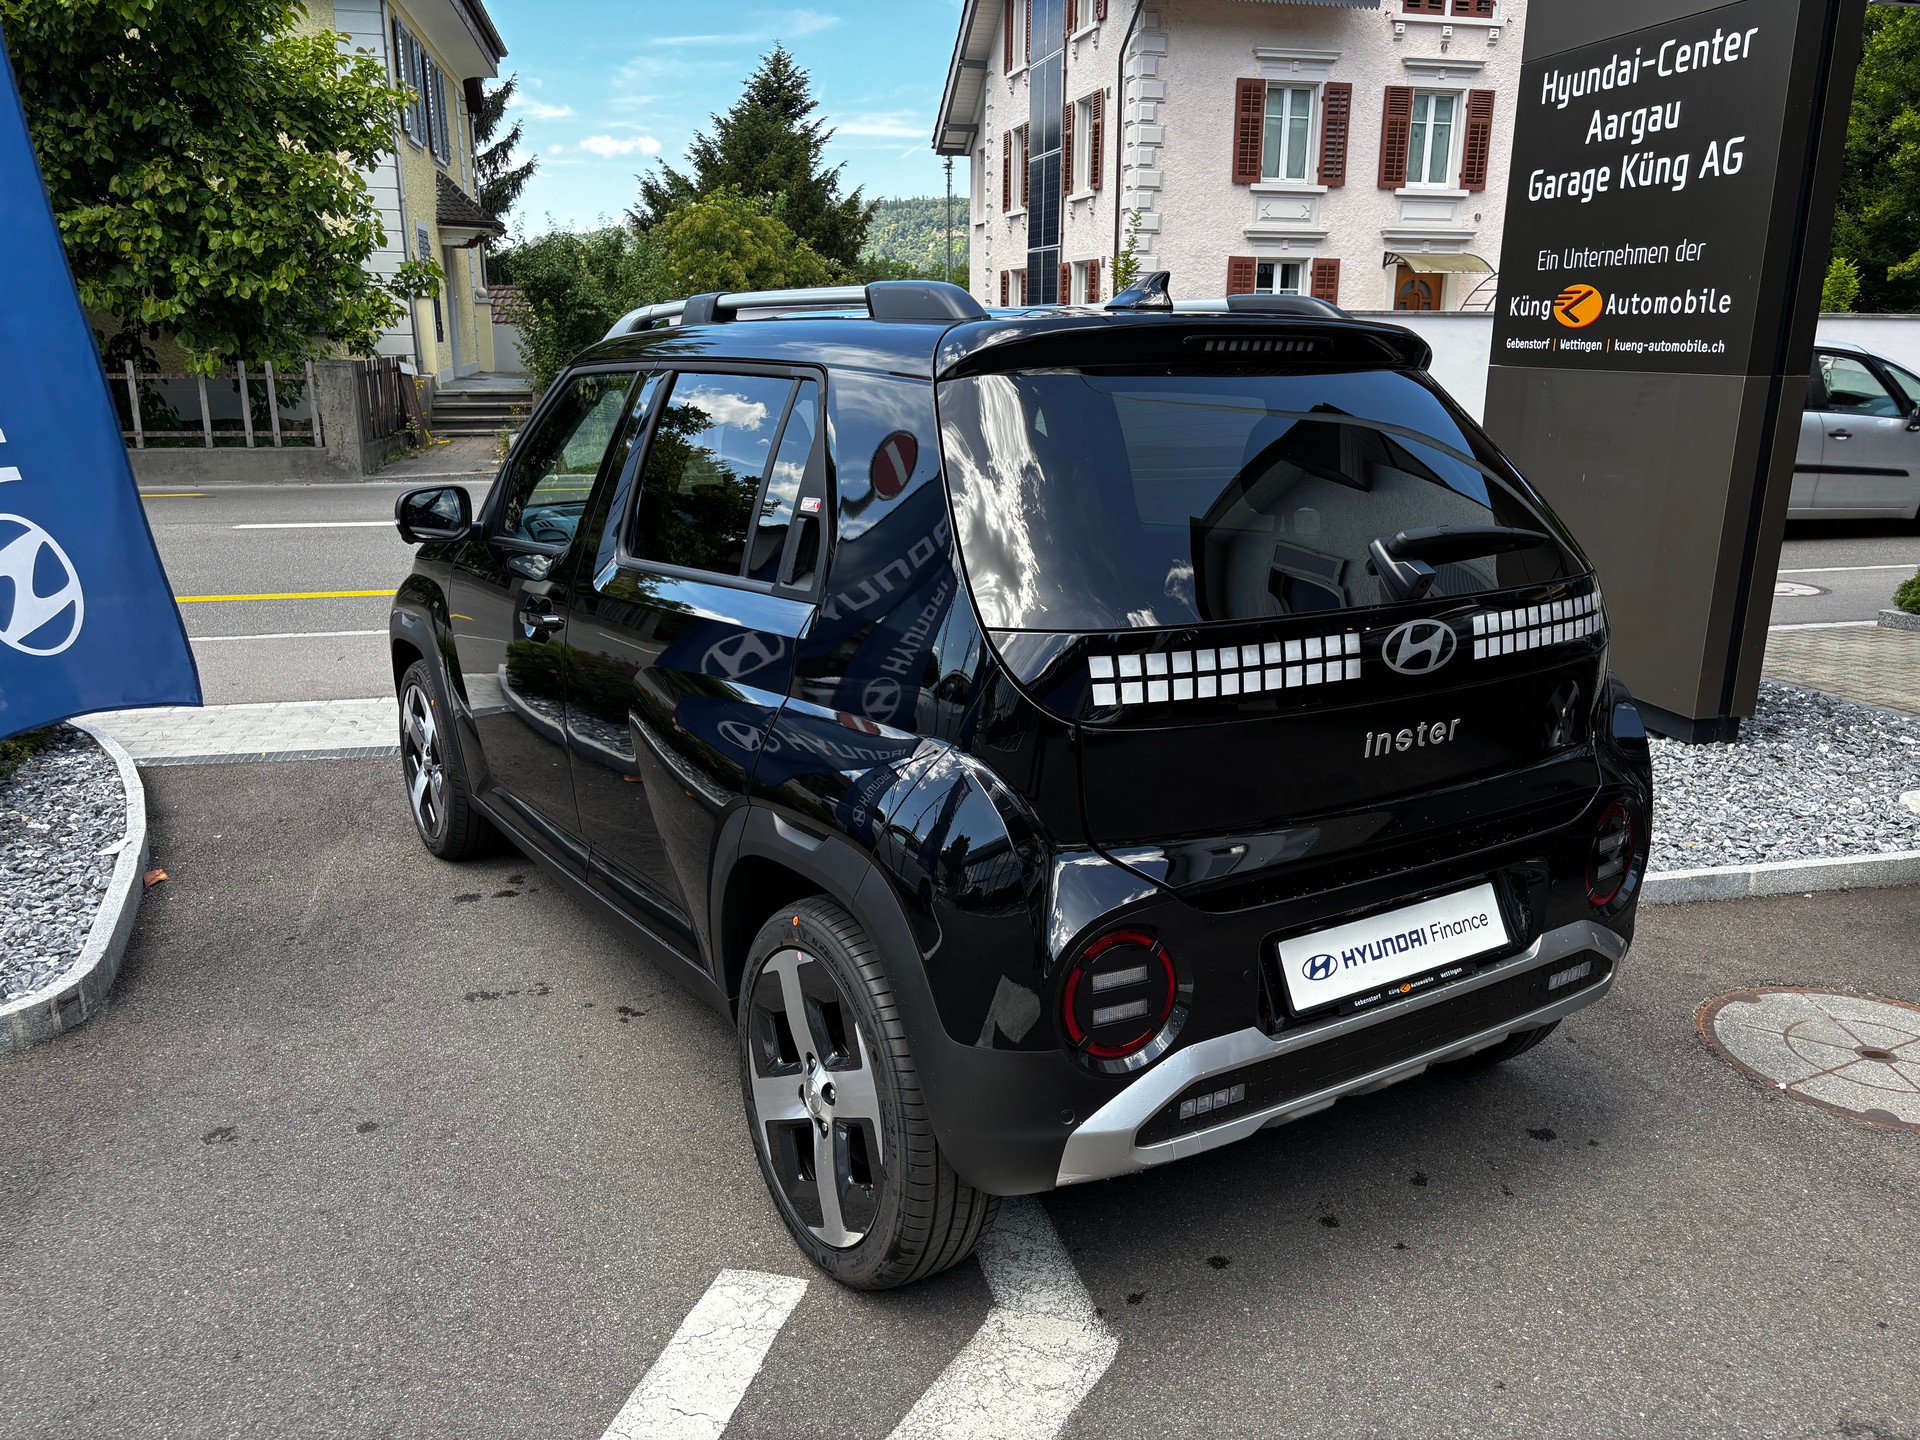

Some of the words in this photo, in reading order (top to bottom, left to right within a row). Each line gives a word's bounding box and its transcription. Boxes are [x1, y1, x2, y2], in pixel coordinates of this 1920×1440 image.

[1541, 27, 1759, 110] Hyundai-Center
[1584, 101, 1682, 145] Aargau
[1528, 165, 1611, 204] Garage
[1619, 152, 1690, 192] Küng
[1698, 136, 1746, 178] AG
[1537, 249, 1559, 271] Ein
[1563, 243, 1669, 270] Unternehmen
[1675, 239, 1707, 262] der
[1509, 295, 1551, 321] Küng
[1605, 288, 1732, 315] Automobile
[1506, 338, 1550, 350] Gebenstorf
[1560, 338, 1602, 352] Wettingen
[1614, 339, 1725, 354] kueng-automobile.ch
[771, 727, 907, 760] HYUNDAI
[1364, 718, 1461, 758] inster
[1341, 928, 1428, 969] HYUNDAI
[1430, 913, 1489, 943] Finance
[1354, 993, 1382, 1007] Gebenstorf
[1411, 976, 1434, 988] Automobile
[1439, 966, 1463, 979] Wettingen
